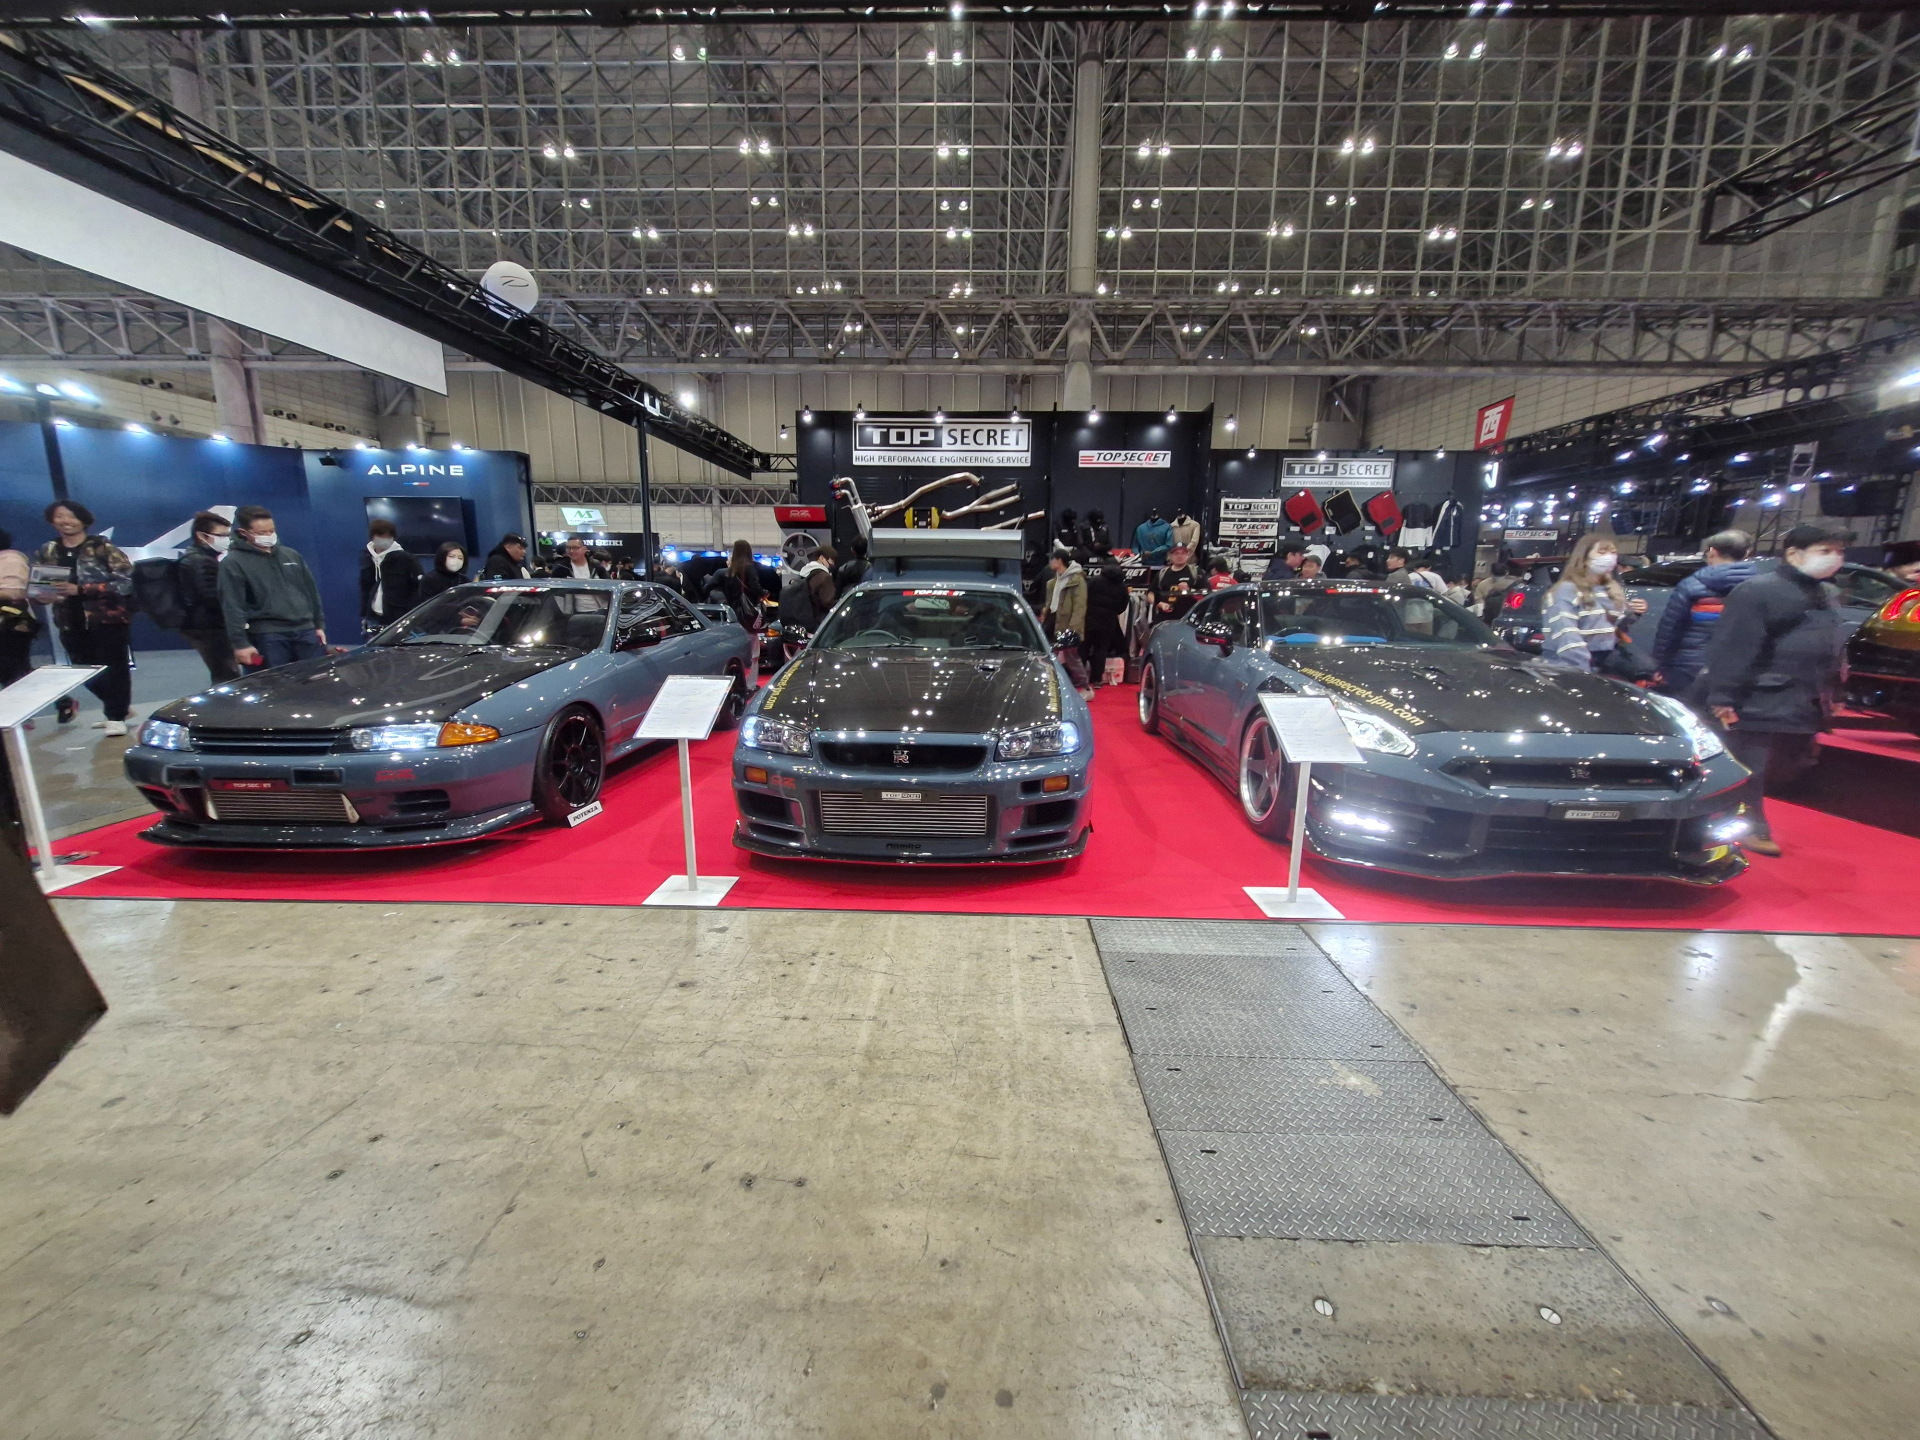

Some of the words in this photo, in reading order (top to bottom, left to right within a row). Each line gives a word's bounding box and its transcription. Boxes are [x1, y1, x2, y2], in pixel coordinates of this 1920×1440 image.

[1480, 405, 1505, 444] 西
[866, 428, 935, 445] TOP
[946, 428, 1024, 446] SECRET
[854, 455, 875, 463] HIGH
[877, 455, 937, 464] PERFORMANCE
[939, 455, 994, 464] ENGINEERING
[996, 456, 1030, 464] SERVICE
[1096, 452, 1122, 461] TOP
[1122, 452, 1170, 462] SECRET
[367, 464, 465, 476] ALPINE
[1291, 463, 1335, 475] TOP
[1340, 464, 1389, 476] SECRET
[1301, 666, 1425, 727] www.topsecret-jpn.com
[572, 805, 599, 822] POTENZA
